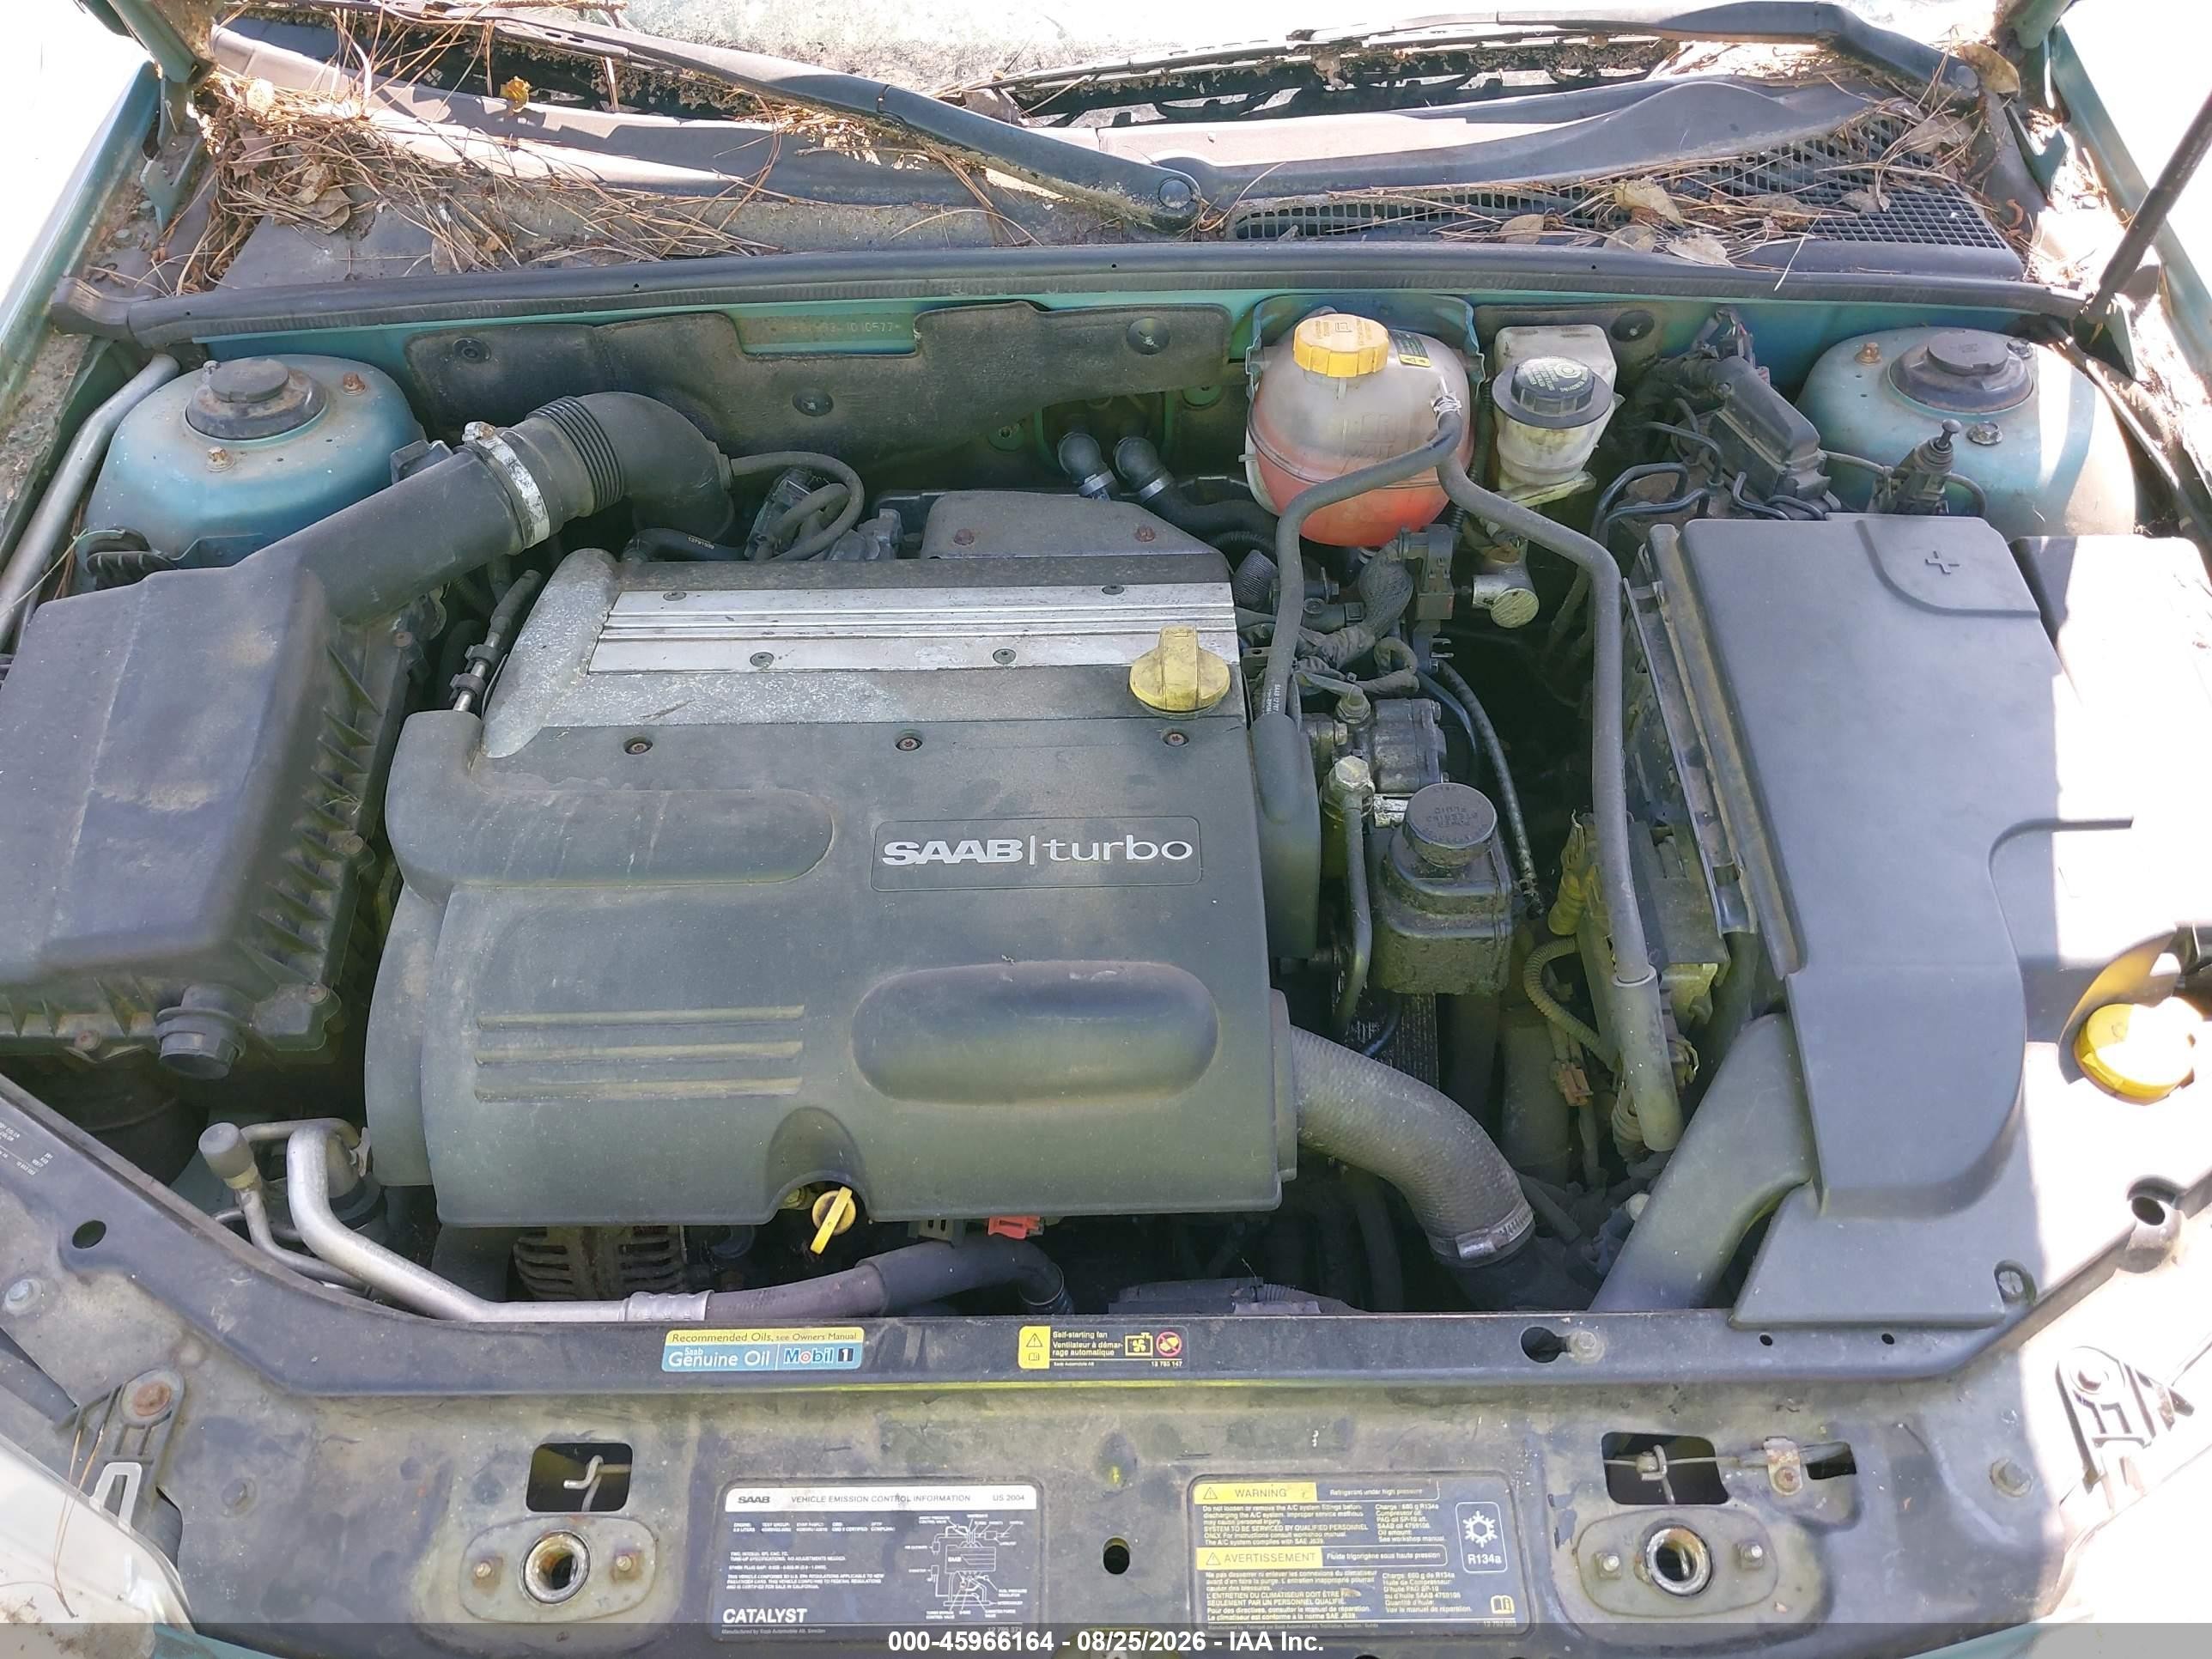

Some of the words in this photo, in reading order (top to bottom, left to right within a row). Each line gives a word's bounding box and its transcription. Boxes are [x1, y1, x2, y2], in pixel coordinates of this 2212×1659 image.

[883, 839, 1023, 866] SAAB
[1042, 835, 1193, 862] turbo
[672, 1334, 747, 1342] Recommended
[751, 1333, 774, 1342] Oils,
[685, 1347, 703, 1356] Saab
[784, 1348, 834, 1364] Mobil
[668, 1352, 738, 1366] Genuine
[744, 1351, 769, 1366] Oil
[871, 1494, 911, 1503] CONTROL
[1235, 1489, 1287, 1498] WARNING
[1224, 1553, 1316, 1562] AVERTISSEMENT
[1468, 1554, 1502, 1565] R134a
[723, 1608, 807, 1623] CATALYST
